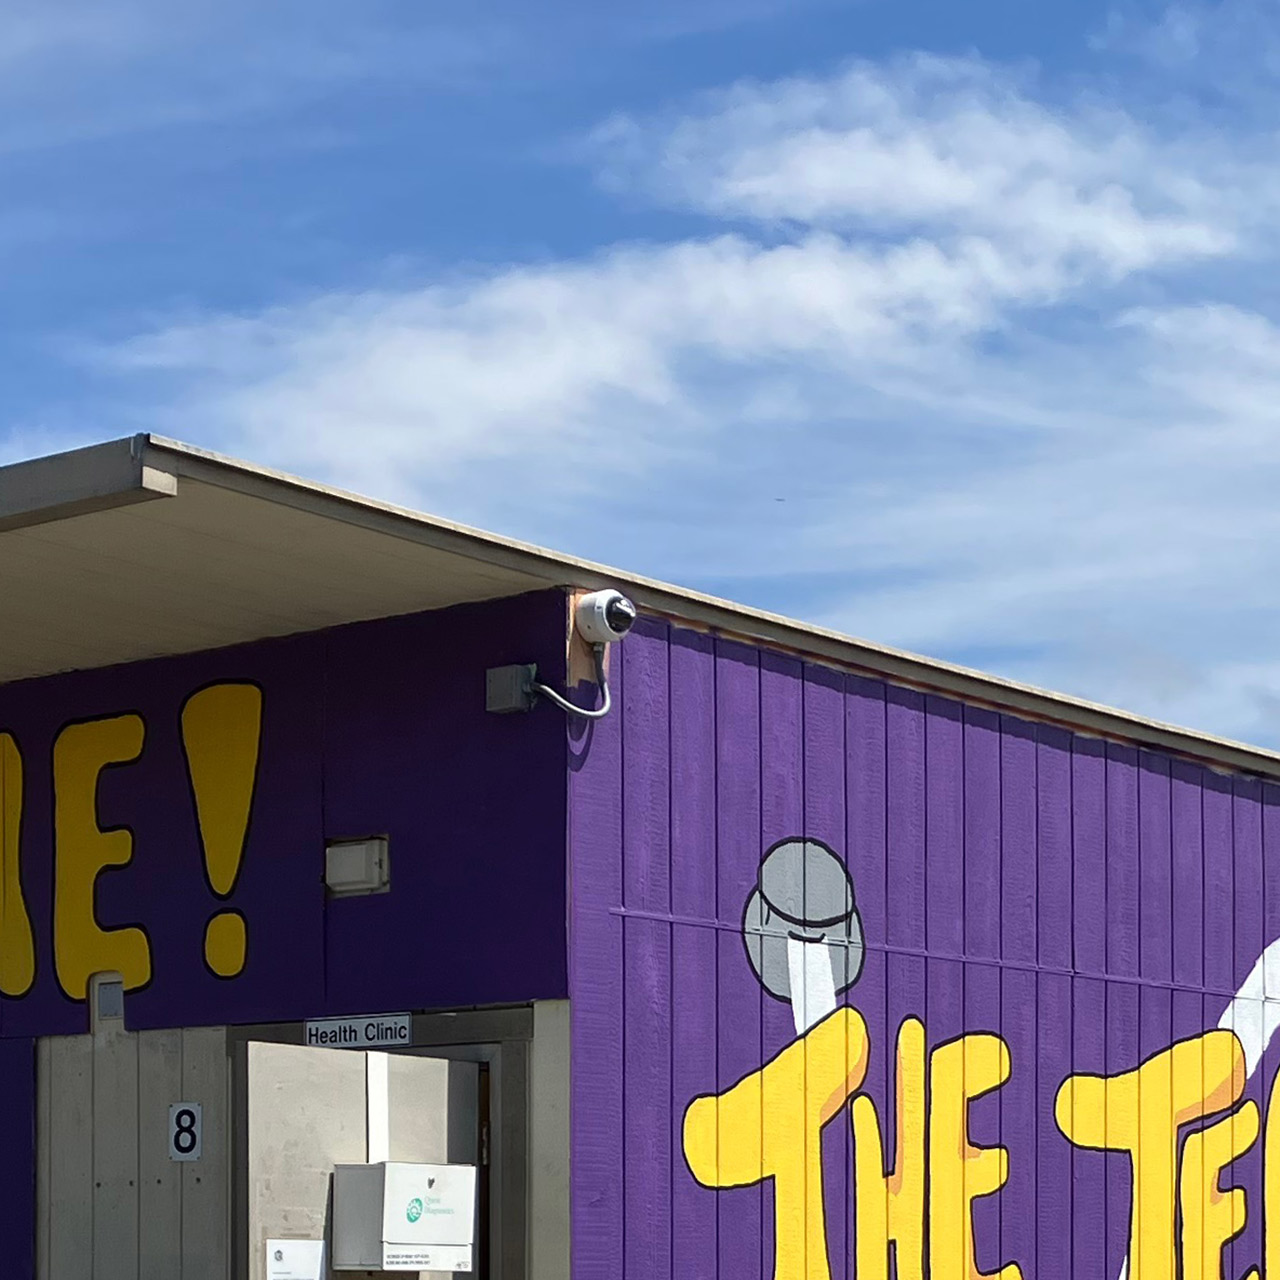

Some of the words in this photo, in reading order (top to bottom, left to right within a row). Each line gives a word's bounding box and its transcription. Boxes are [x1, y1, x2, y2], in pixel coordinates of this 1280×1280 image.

[308, 1026, 358, 1045] Health
[364, 1022, 408, 1041] Clinic
[173, 1108, 197, 1154] 8
